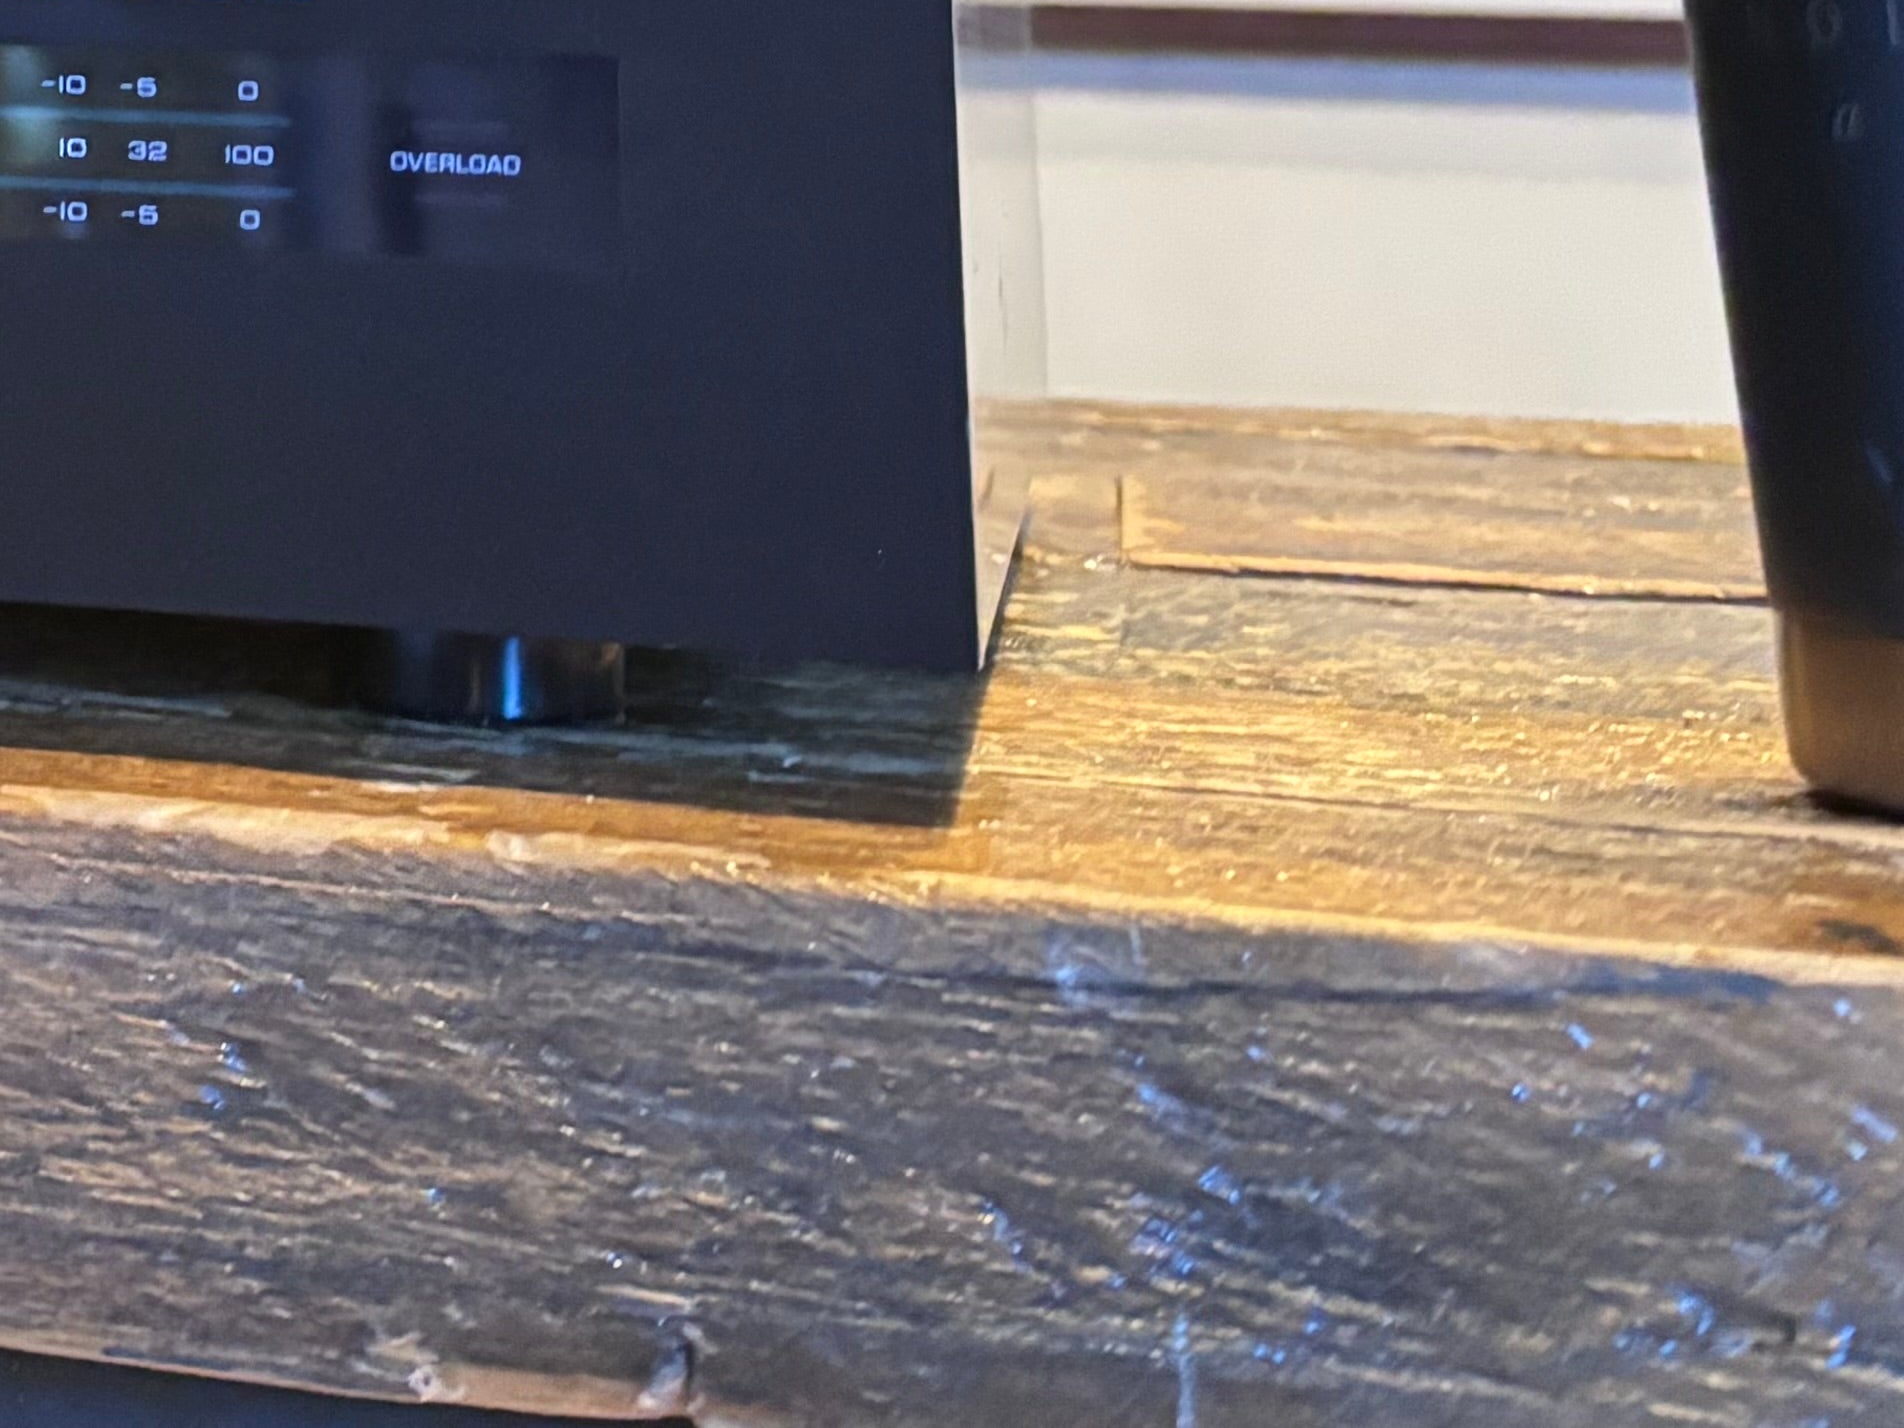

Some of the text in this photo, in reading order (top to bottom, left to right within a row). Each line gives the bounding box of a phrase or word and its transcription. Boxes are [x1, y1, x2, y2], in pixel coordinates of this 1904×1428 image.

[42, 74, 87, 95] -10
[238, 80, 259, 102] 0
[59, 138, 87, 159] 10
[128, 141, 168, 162] 32
[225, 144, 274, 166] 100
[390, 151, 521, 176] OVERLOAD
[44, 201, 88, 222] -10
[240, 209, 261, 231] 0
